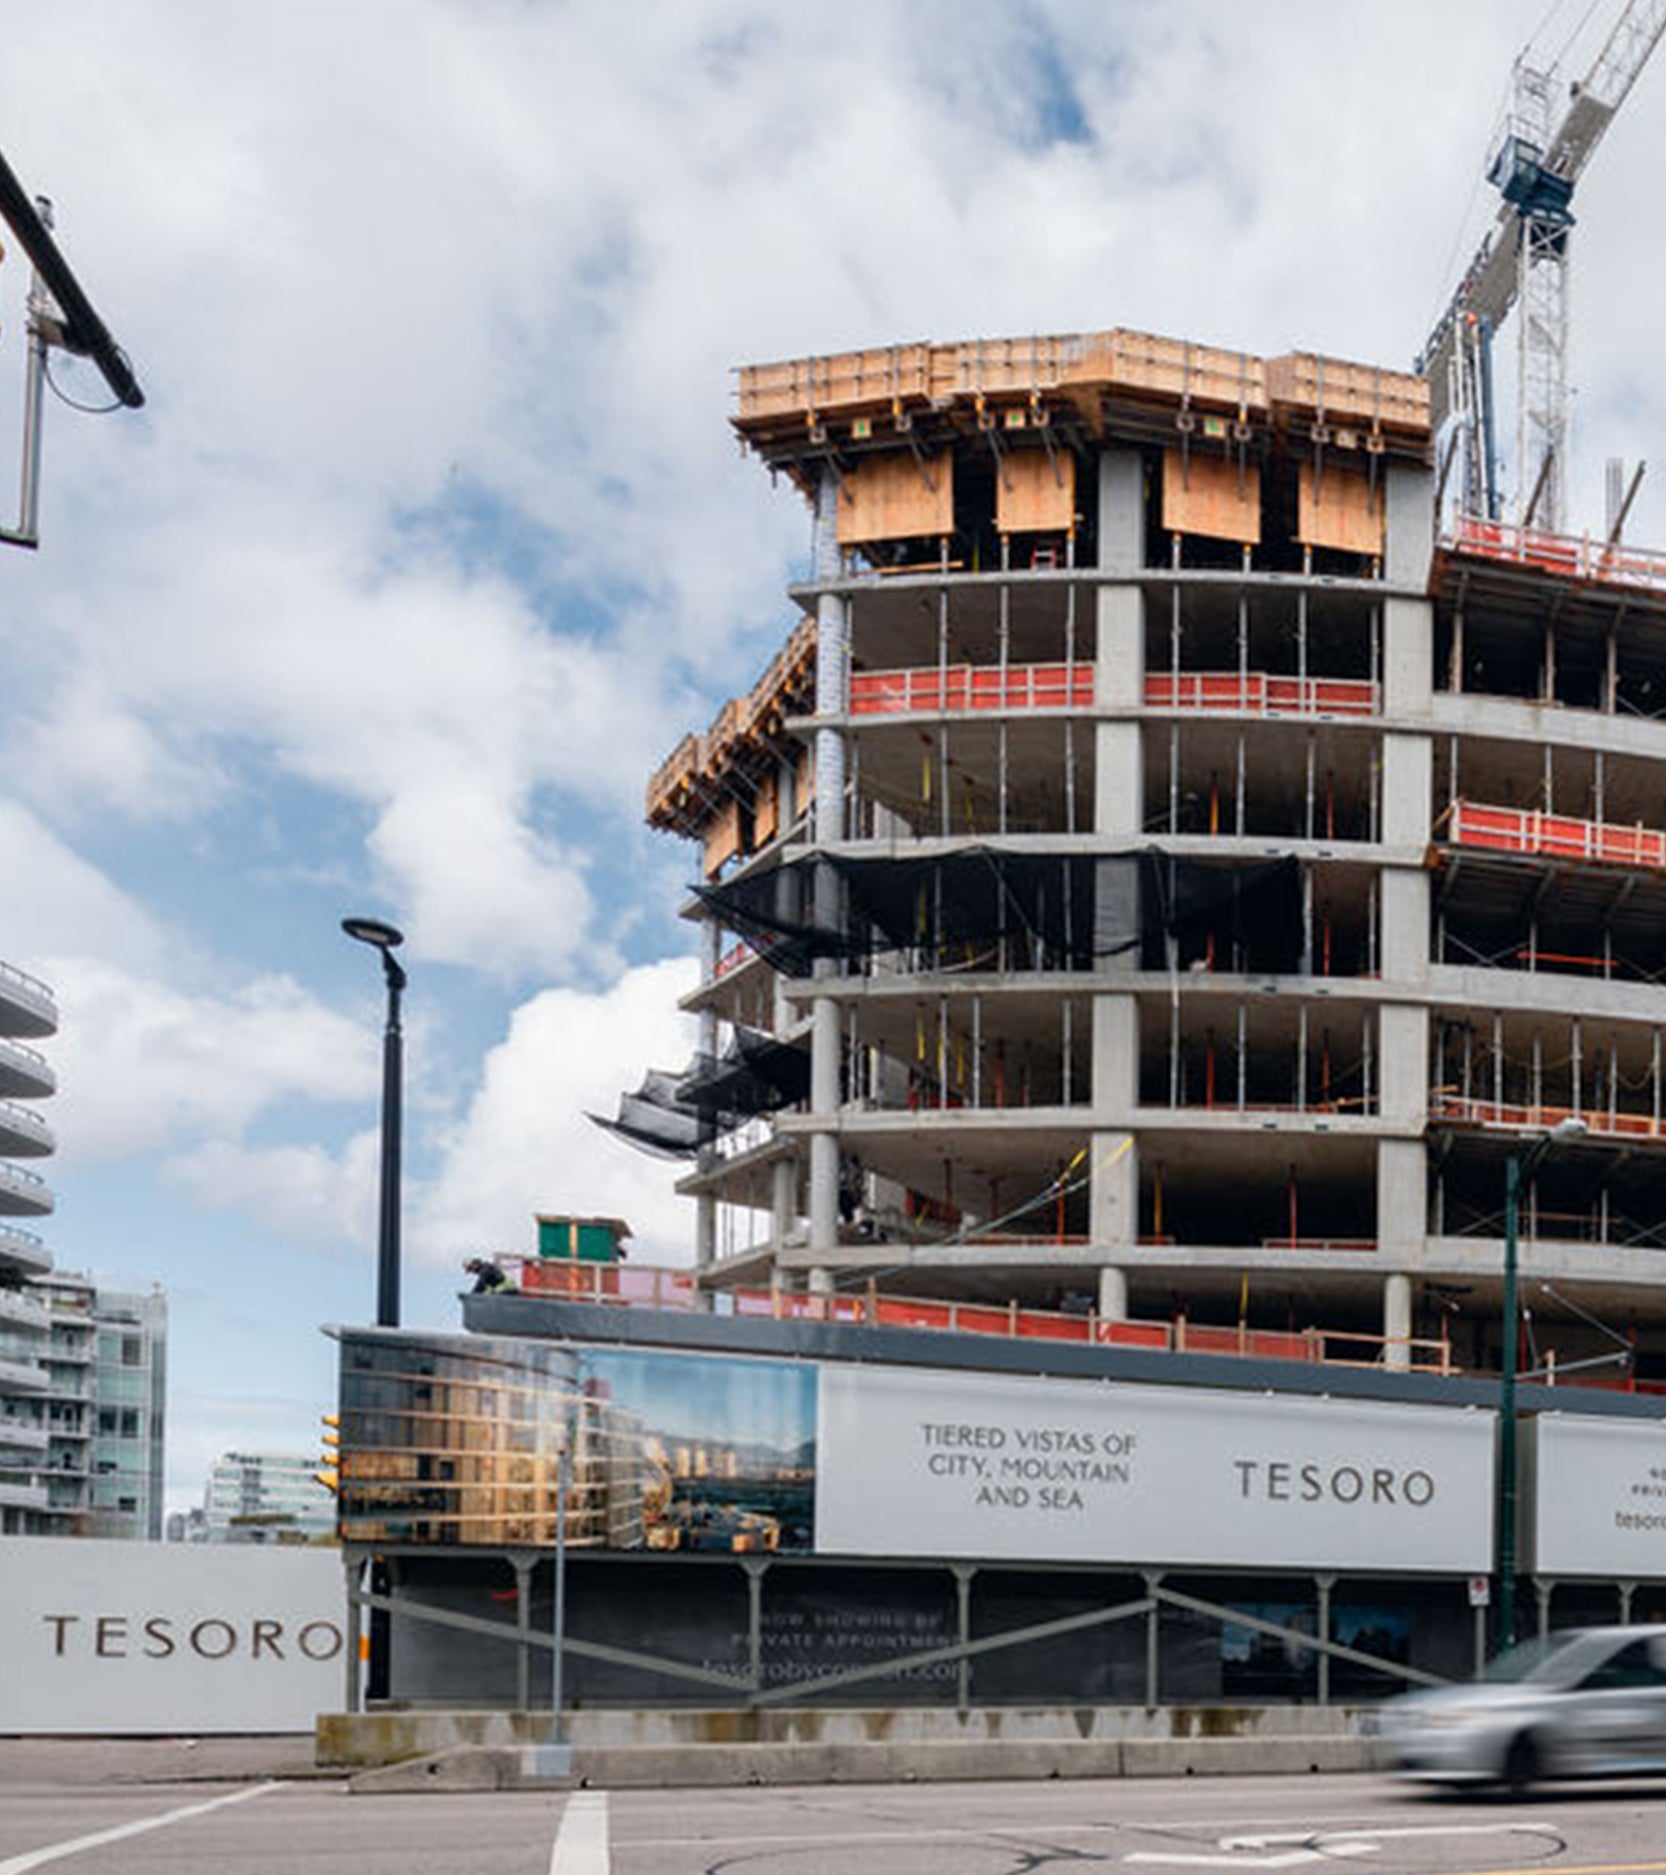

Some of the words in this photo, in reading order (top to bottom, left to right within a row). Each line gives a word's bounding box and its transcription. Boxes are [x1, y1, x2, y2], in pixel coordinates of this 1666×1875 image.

[922, 1423, 1006, 1449] TIERED
[1015, 1429, 1095, 1454] VISTAS
[1103, 1434, 1136, 1456] OF
[1002, 1457, 1129, 1483] MOUNTAIN
[1233, 1460, 1434, 1507] TESORO
[976, 1485, 1030, 1508] AND
[1038, 1487, 1084, 1511] SEA
[42, 1615, 343, 1661] TESORO
